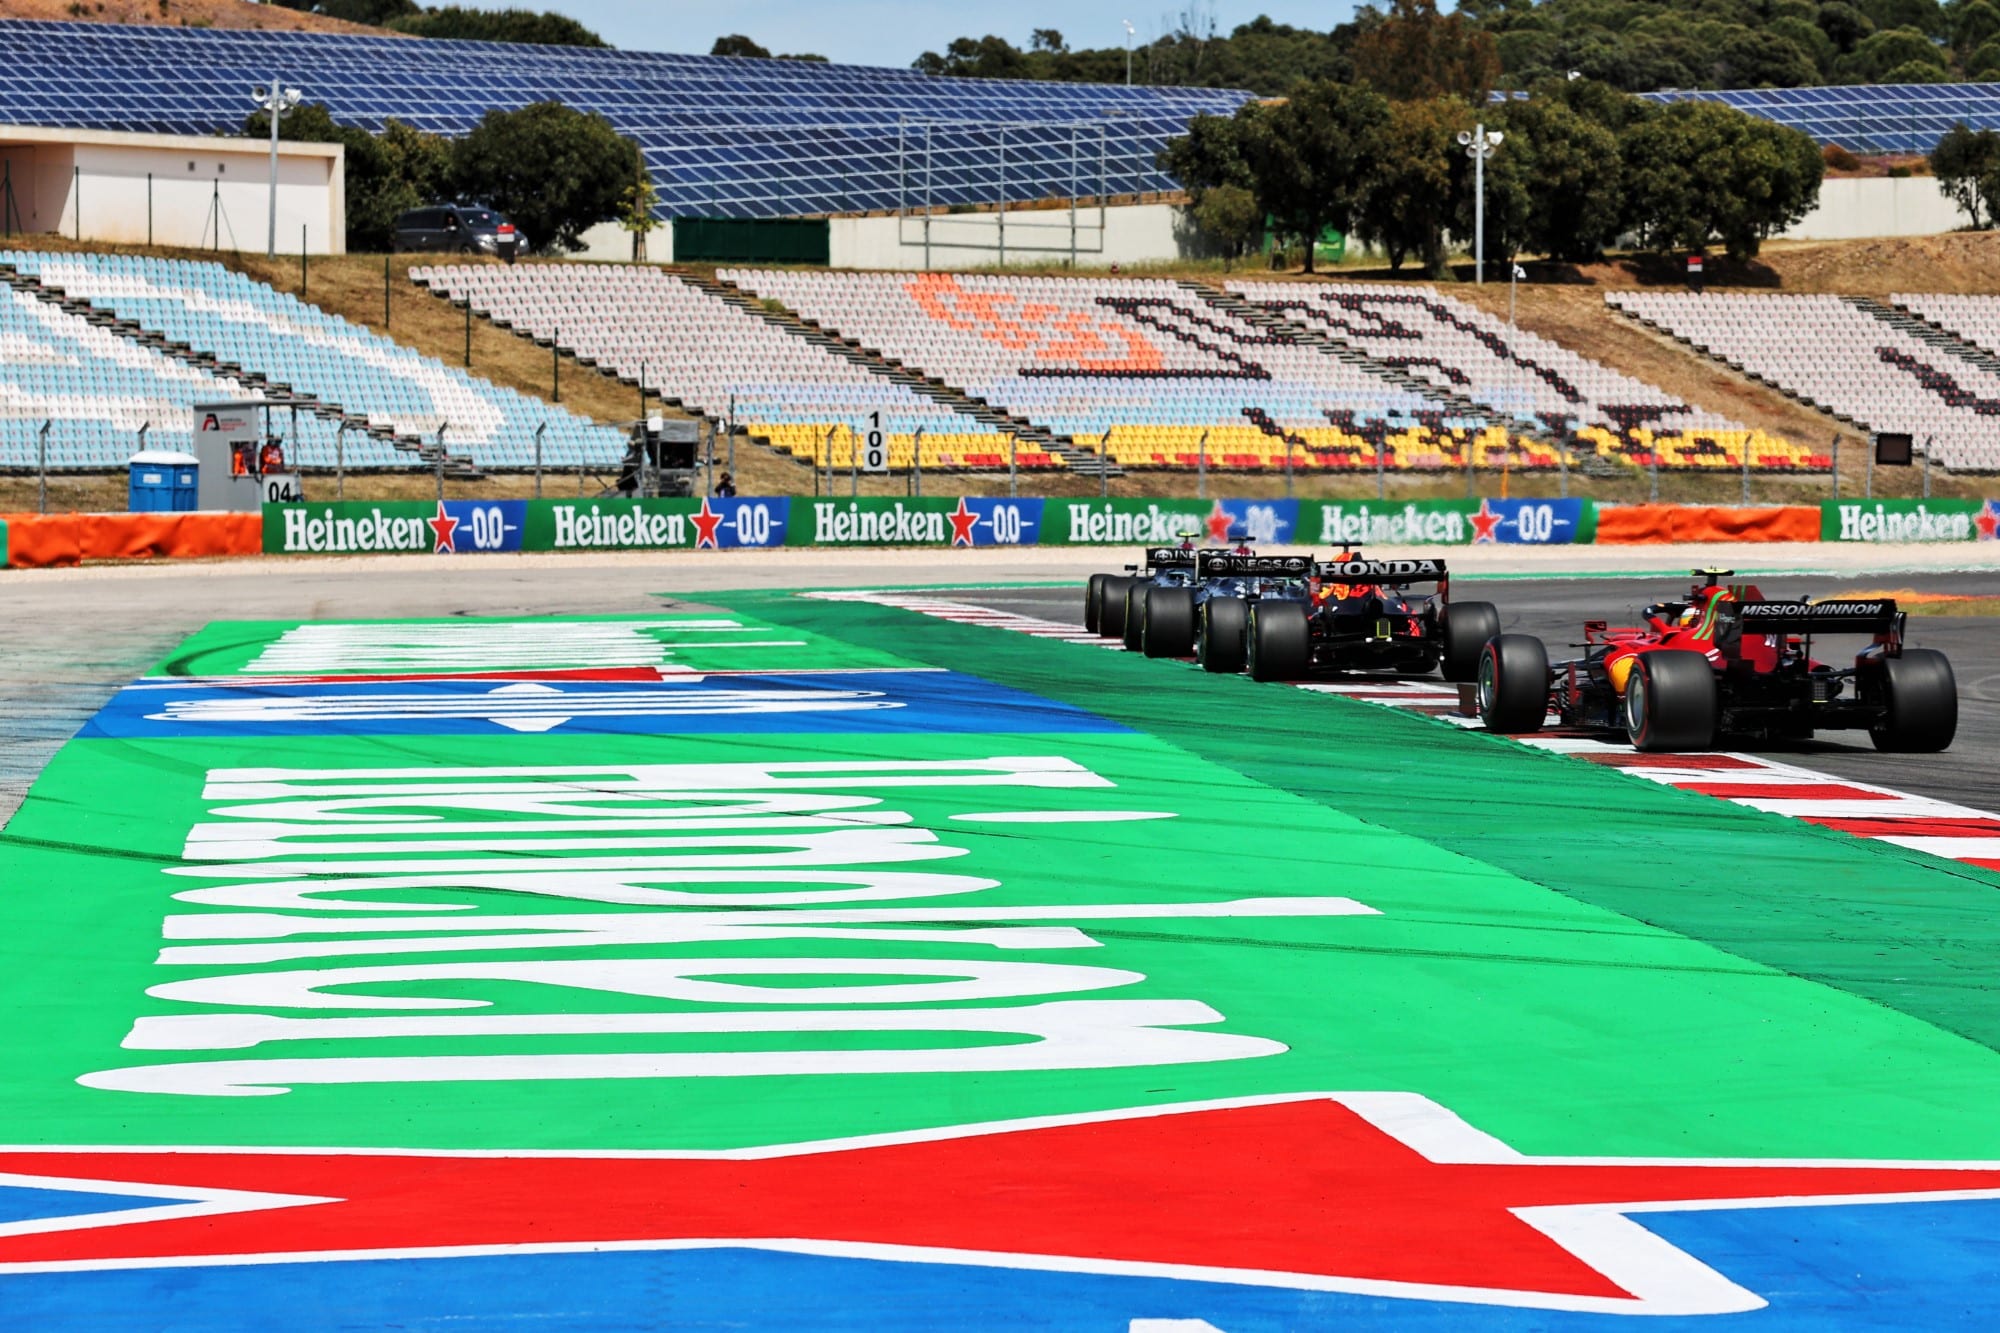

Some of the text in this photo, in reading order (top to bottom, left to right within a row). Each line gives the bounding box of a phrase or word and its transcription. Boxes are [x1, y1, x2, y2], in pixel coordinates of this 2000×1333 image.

[868, 411, 882, 467] 100
[268, 482, 291, 502] 04
[283, 507, 503, 551] Heineken 0.0
[553, 504, 769, 547] Heineken 0.0
[814, 503, 1020, 544] Heineken 0.0
[1068, 504, 1202, 542] Heineken
[1321, 504, 1463, 543] Heineken
[1838, 504, 1970, 541] Heineken
[1231, 558, 1282, 568] INEOS
[1318, 560, 1439, 576] HONDA
[76, 756, 1383, 1097] Heineken
